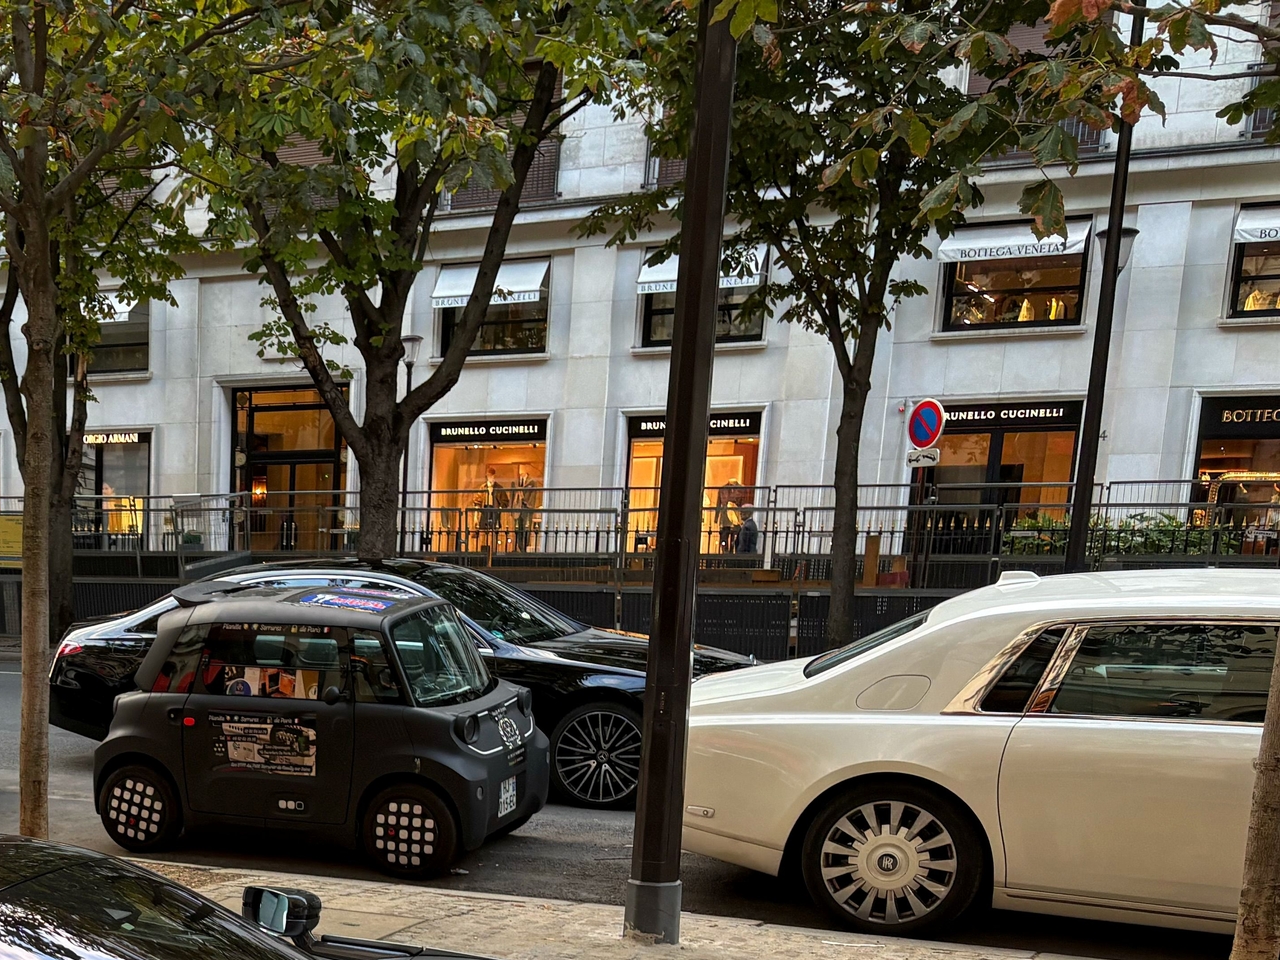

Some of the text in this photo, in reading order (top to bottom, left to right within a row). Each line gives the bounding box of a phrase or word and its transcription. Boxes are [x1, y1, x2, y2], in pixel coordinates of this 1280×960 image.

[960, 242, 1060, 259] BOTTEGA VENETA
[641, 283, 675, 292] BRUNE
[944, 408, 1064, 421] RUNELLO CUCINELLI
[641, 418, 750, 430] BRUN CINELLI
[441, 425, 539, 436] BRUNELLO CUCINELLI
[82, 433, 139, 444] ORGIO ARMANI
